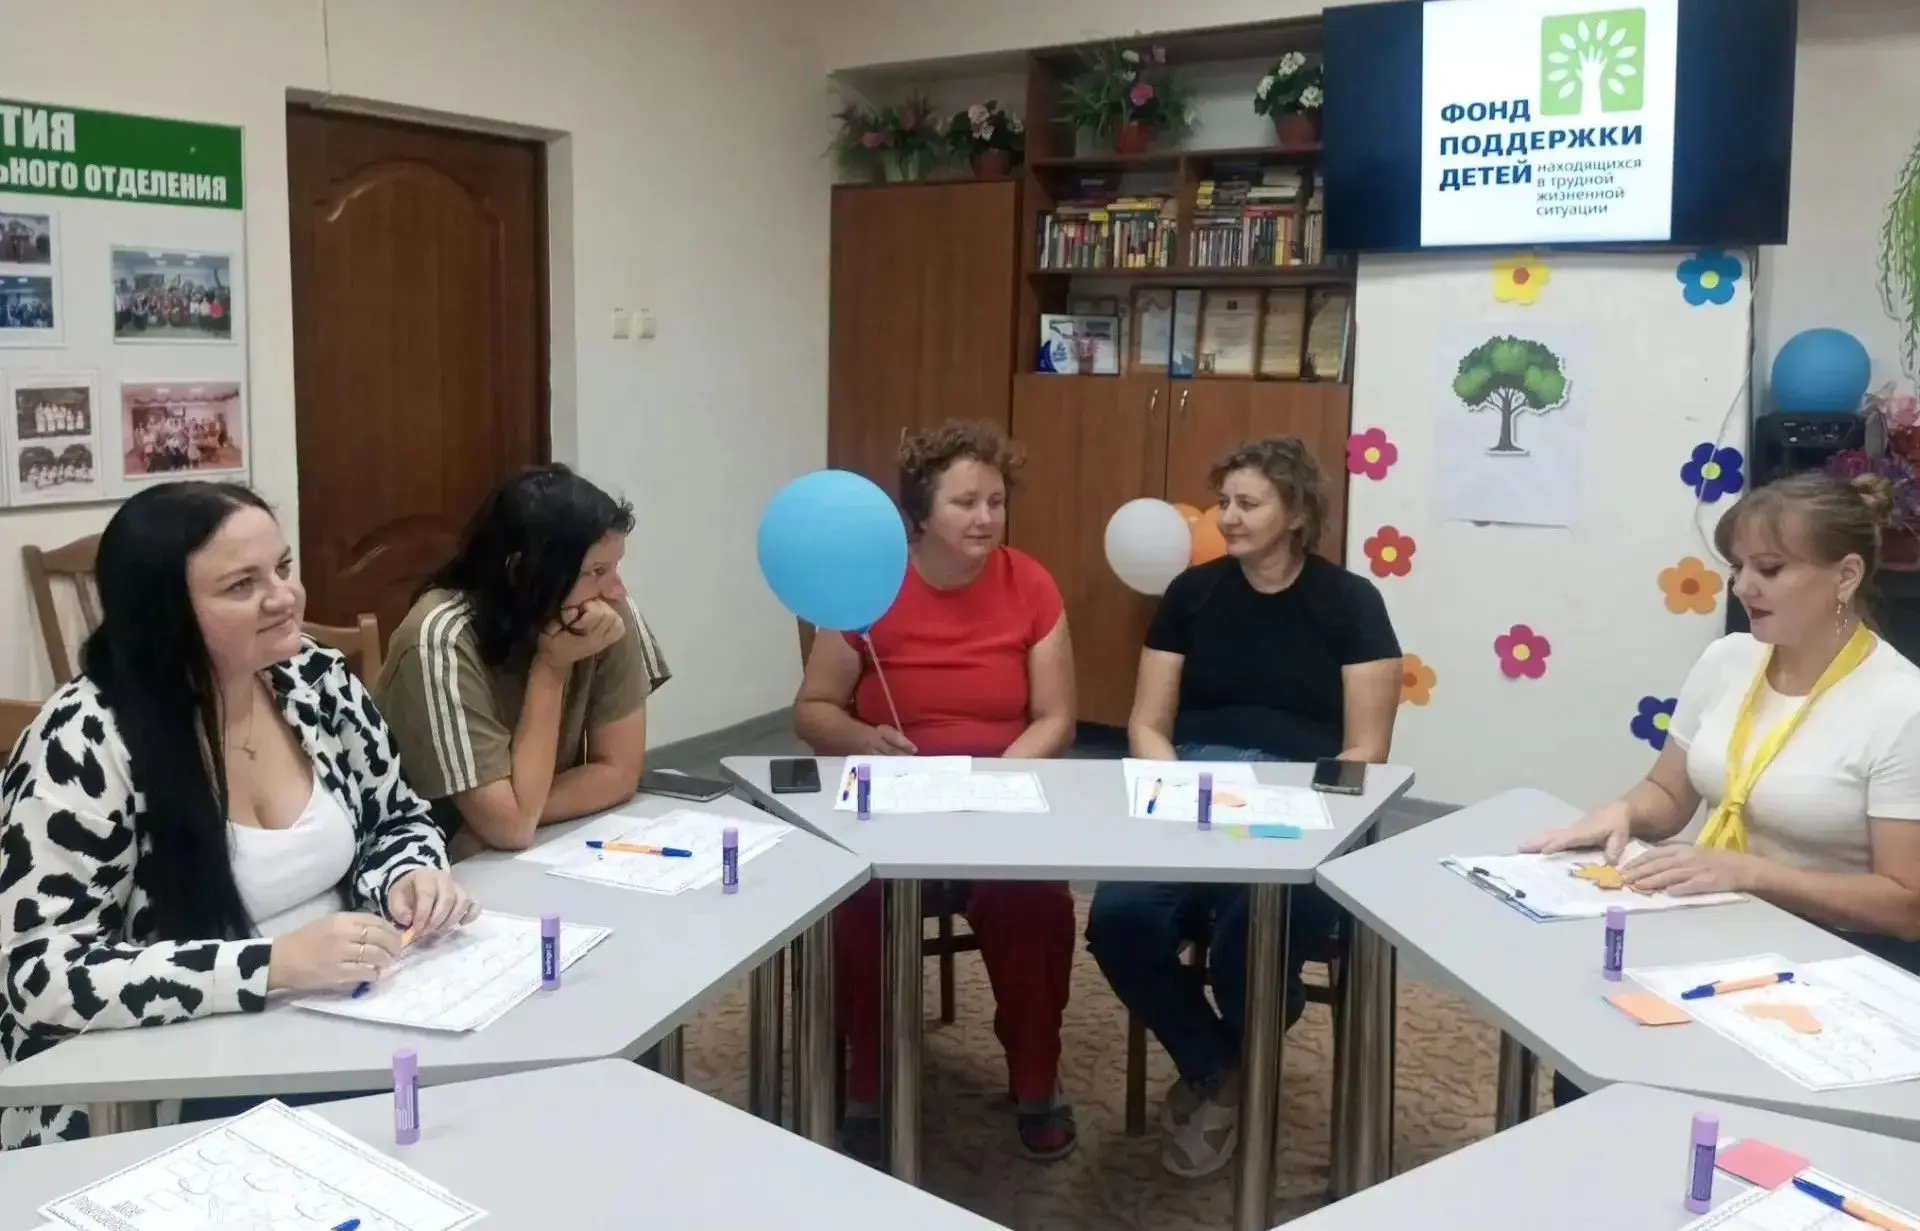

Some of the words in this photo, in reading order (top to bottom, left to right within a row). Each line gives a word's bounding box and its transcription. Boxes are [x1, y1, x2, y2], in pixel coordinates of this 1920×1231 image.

[1440, 99, 1531, 124] ФОНД
[0, 104, 76, 153] ТИЯ
[1440, 125, 1642, 157] ПОДДЕРЖКИ
[1439, 159, 1532, 192] ДЕТЕЙ
[1537, 158, 1642, 174] находящихся
[84, 164, 227, 202] ОТДЕЛЕНИЯ
[1537, 178, 1545, 188] в
[1551, 173, 1614, 190] трудной
[1536, 187, 1625, 203] жизненной
[1536, 204, 1609, 219] ситуации
